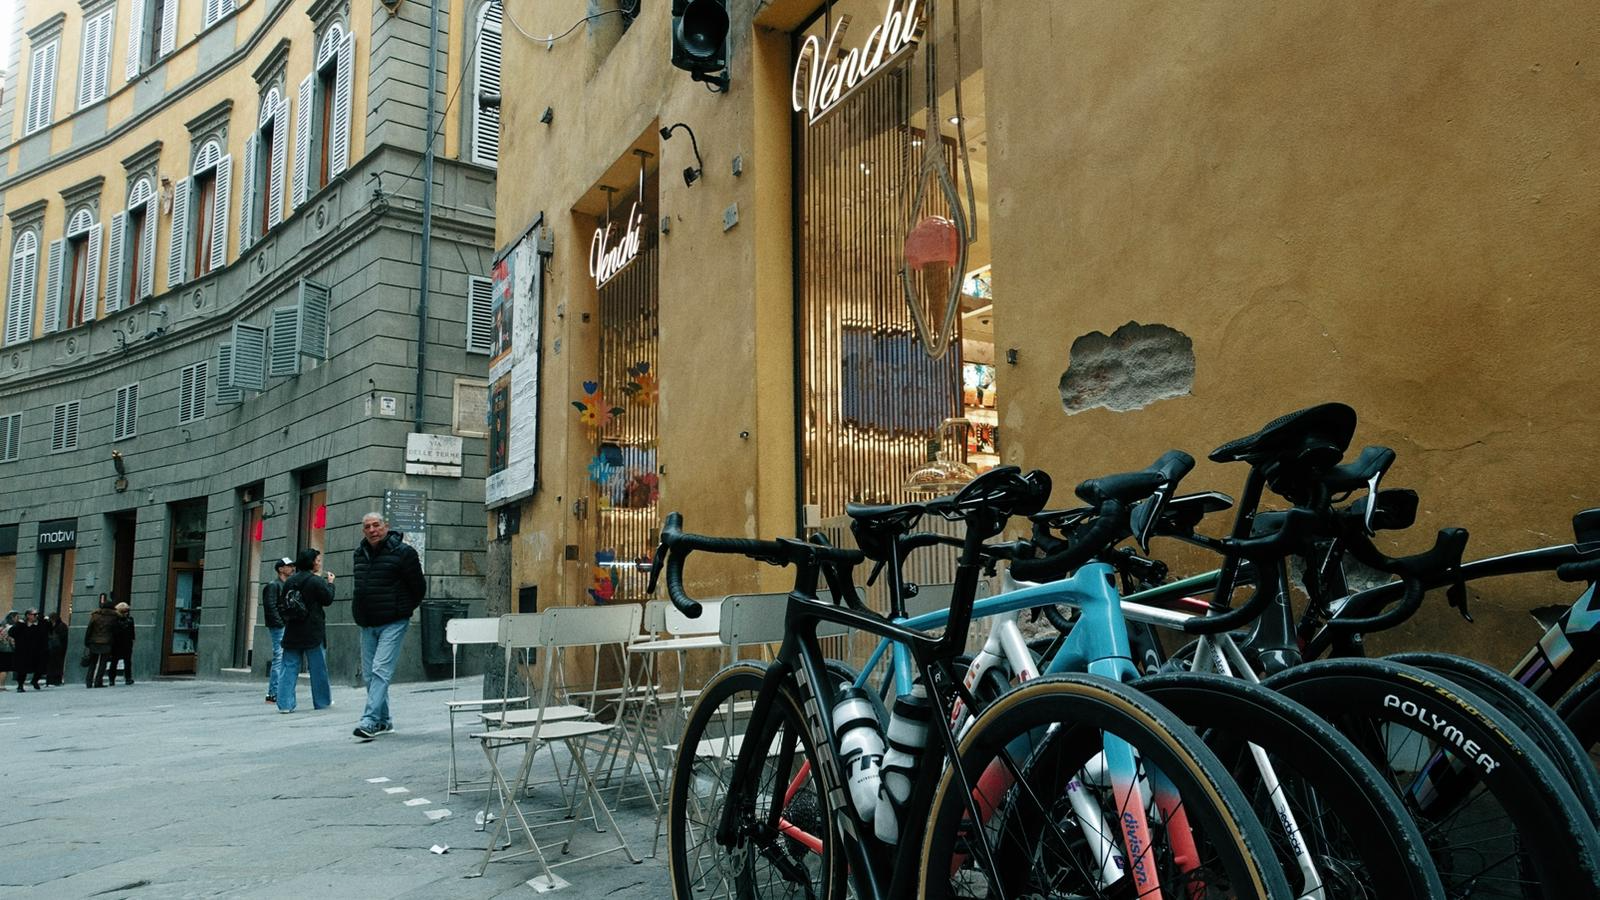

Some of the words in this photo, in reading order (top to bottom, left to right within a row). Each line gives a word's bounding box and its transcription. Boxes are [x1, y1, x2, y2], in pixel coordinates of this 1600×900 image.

[792, 0, 920, 120] Venchi
[589, 201, 643, 286] Venchi
[408, 449, 433, 457] DELLE
[39, 529, 75, 543] motivi
[1384, 694, 1497, 774] POLYMER
